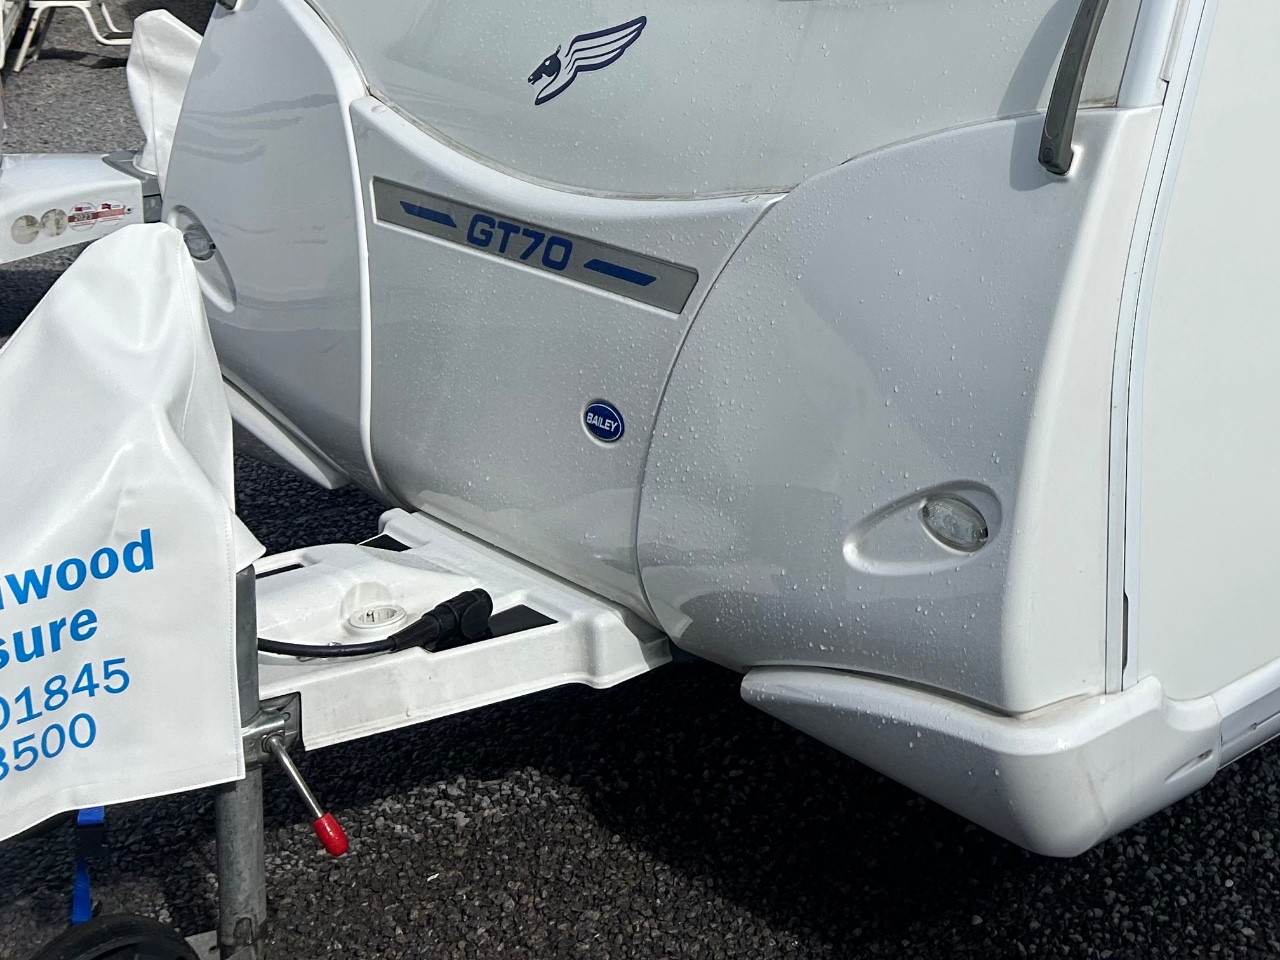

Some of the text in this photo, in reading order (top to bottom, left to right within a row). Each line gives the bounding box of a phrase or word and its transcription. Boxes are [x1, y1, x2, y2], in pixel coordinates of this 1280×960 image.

[467, 213, 573, 271] GT70
[586, 412, 618, 432] BAILEY
[0, 528, 154, 610] wood
